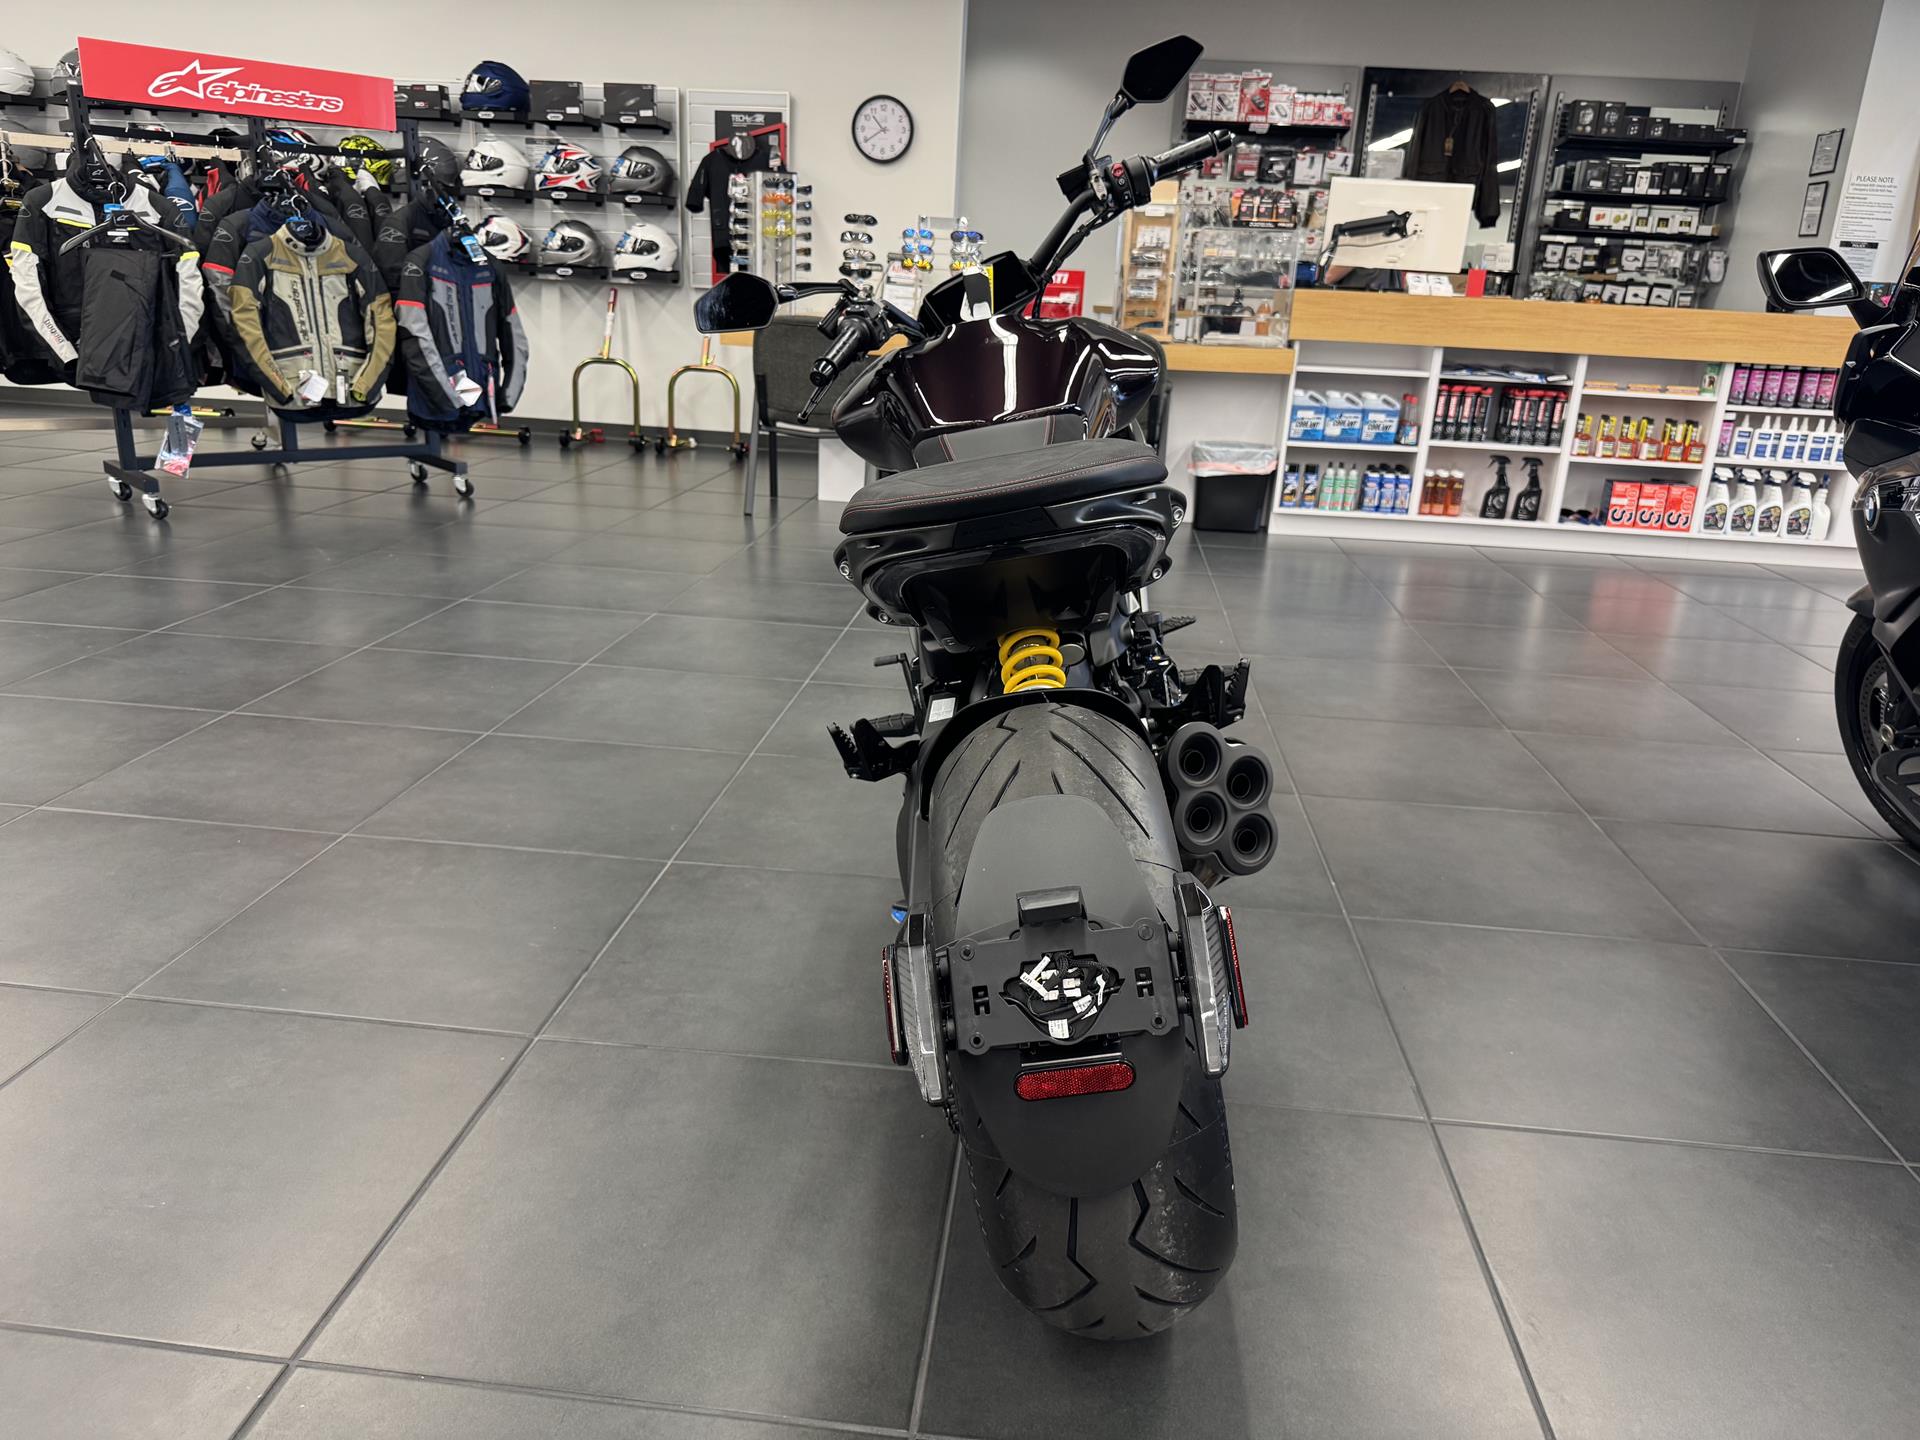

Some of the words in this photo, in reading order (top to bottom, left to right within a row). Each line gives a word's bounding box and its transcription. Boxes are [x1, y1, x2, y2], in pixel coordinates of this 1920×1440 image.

[206, 81, 344, 113] alpinestars
[870, 107, 877, 115] 11
[880, 103, 888, 112] 12
[863, 113, 871, 121] 10
[860, 125, 866, 133] 9
[901, 126, 906, 134] 3
[880, 147, 885, 155] 6
[1856, 175, 1877, 183] PLEASE
[1878, 176, 1895, 184] NOTE
